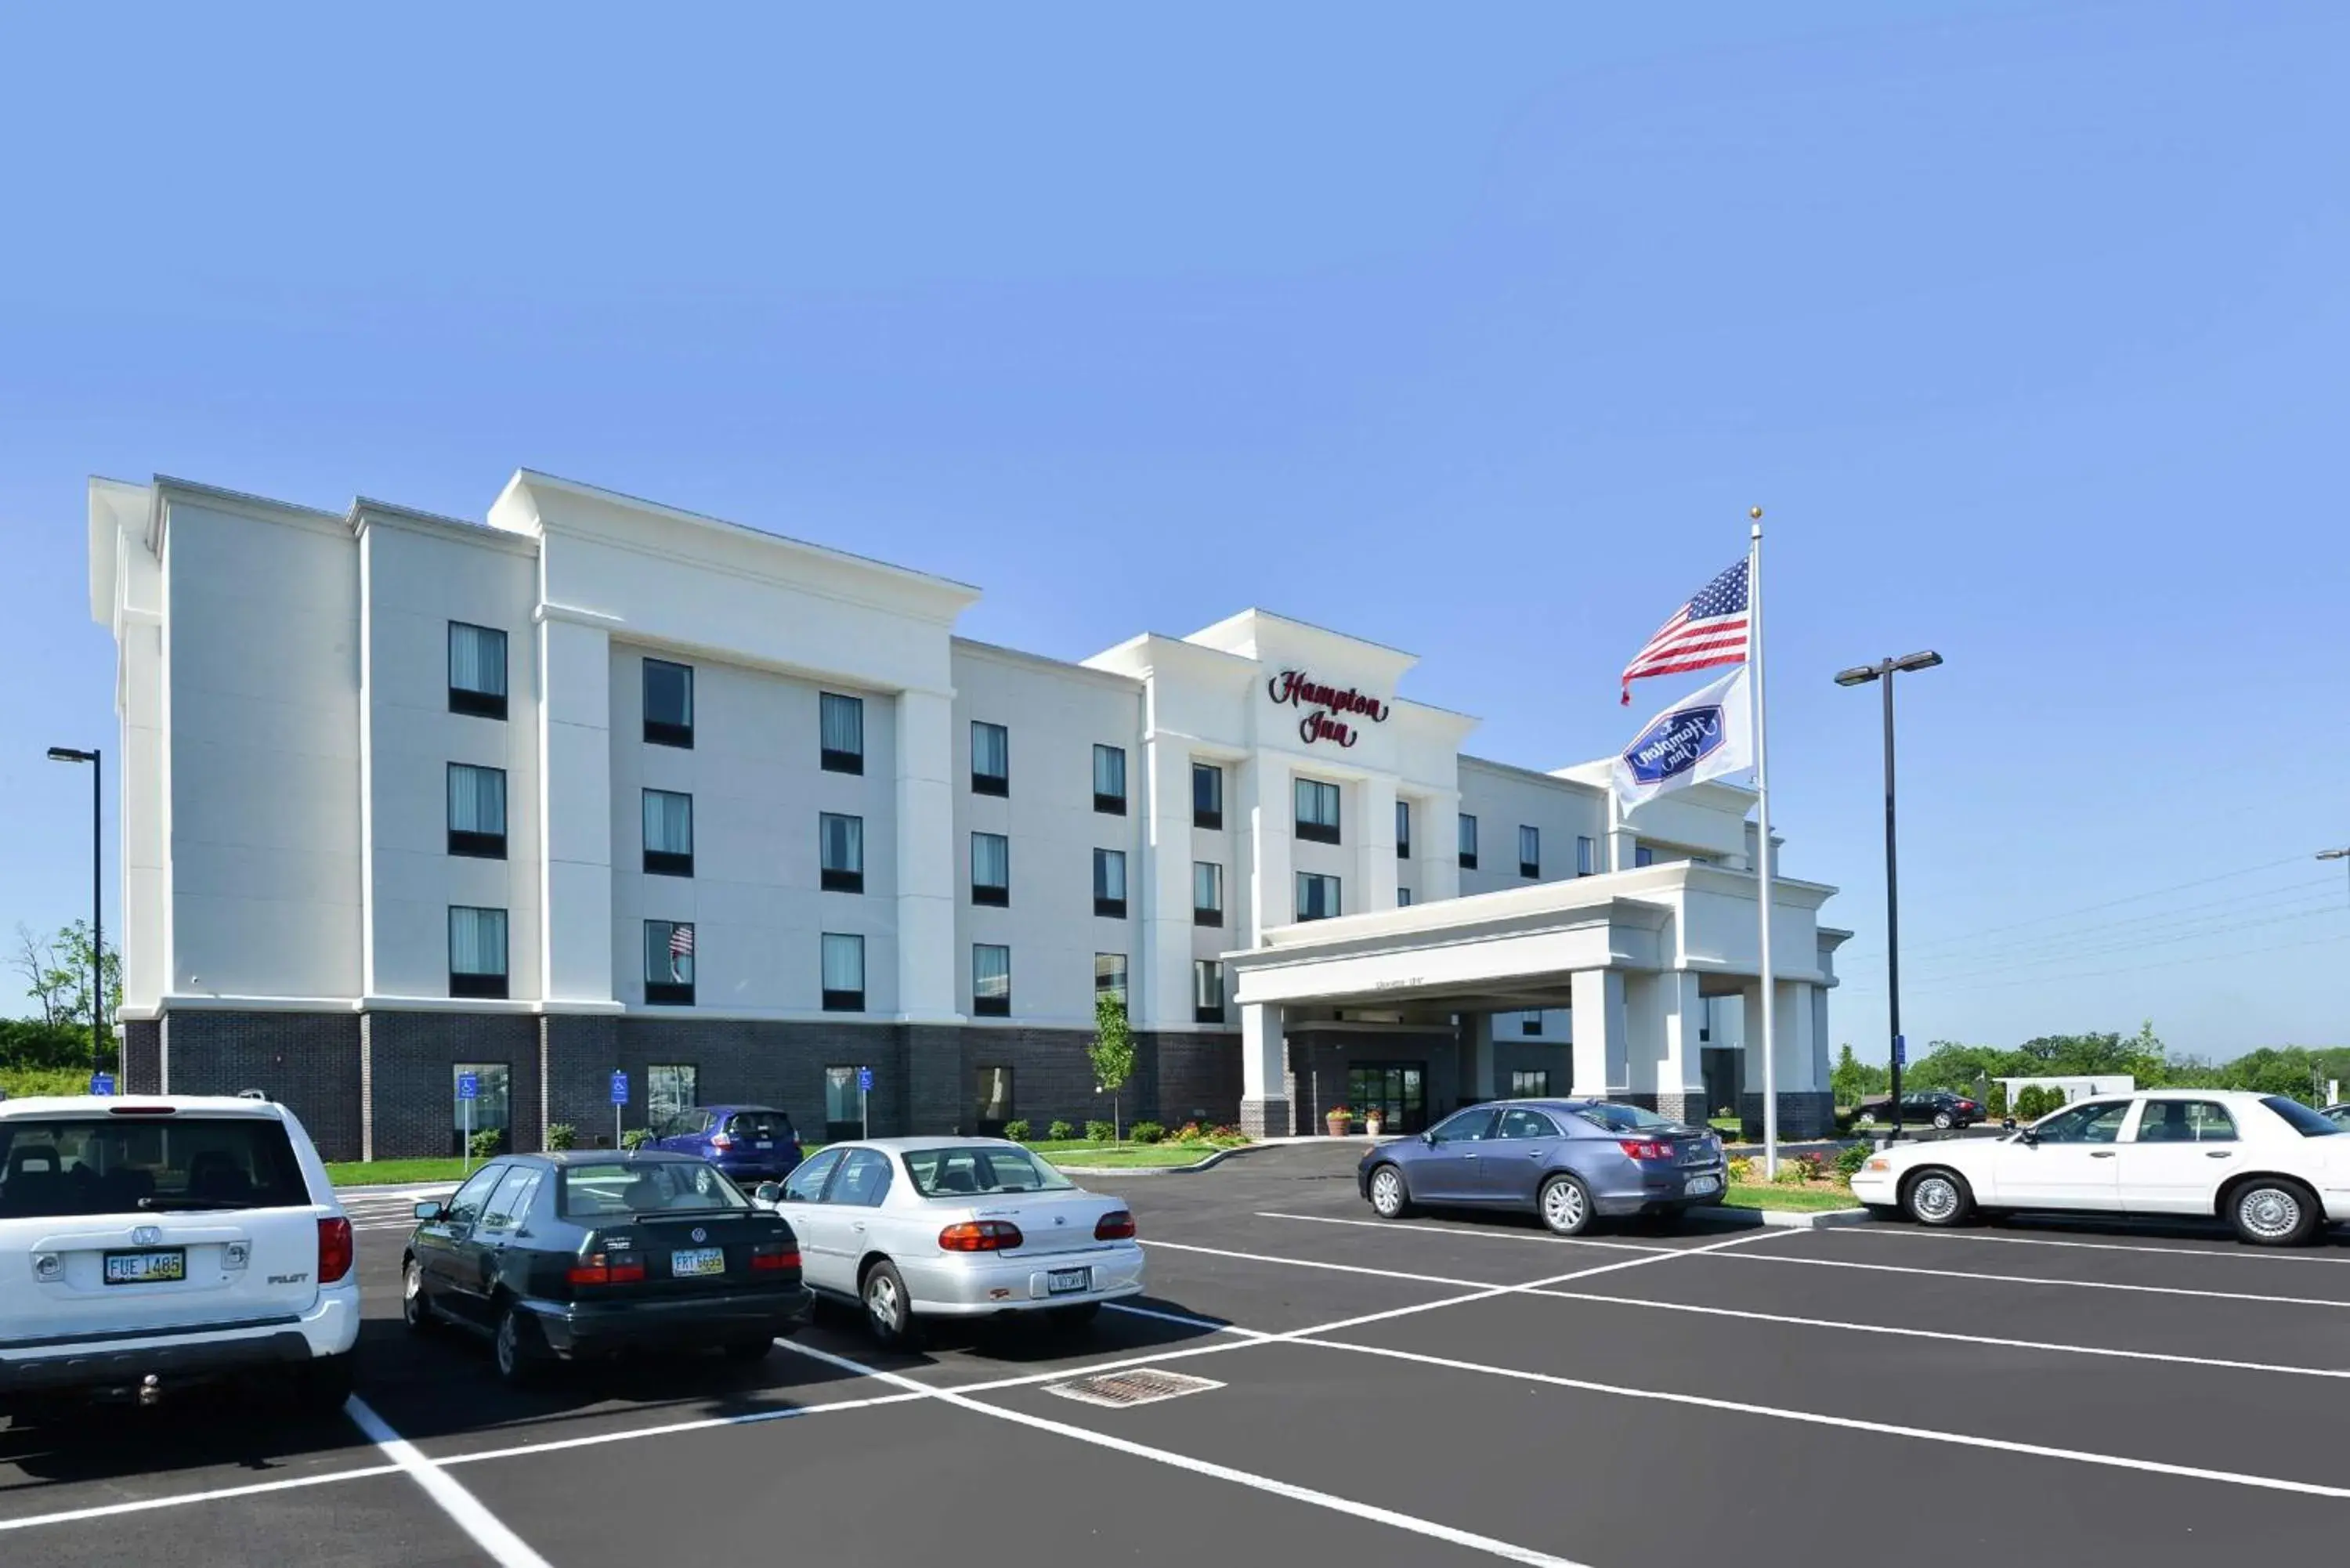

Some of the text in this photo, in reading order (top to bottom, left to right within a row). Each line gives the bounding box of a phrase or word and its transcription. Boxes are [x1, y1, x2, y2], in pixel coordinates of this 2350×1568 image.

[1268, 670, 1389, 722] Hampton
[1300, 710, 1358, 747] Inn
[110, 1259, 139, 1277] FUE
[267, 1272, 309, 1284] PILOT
